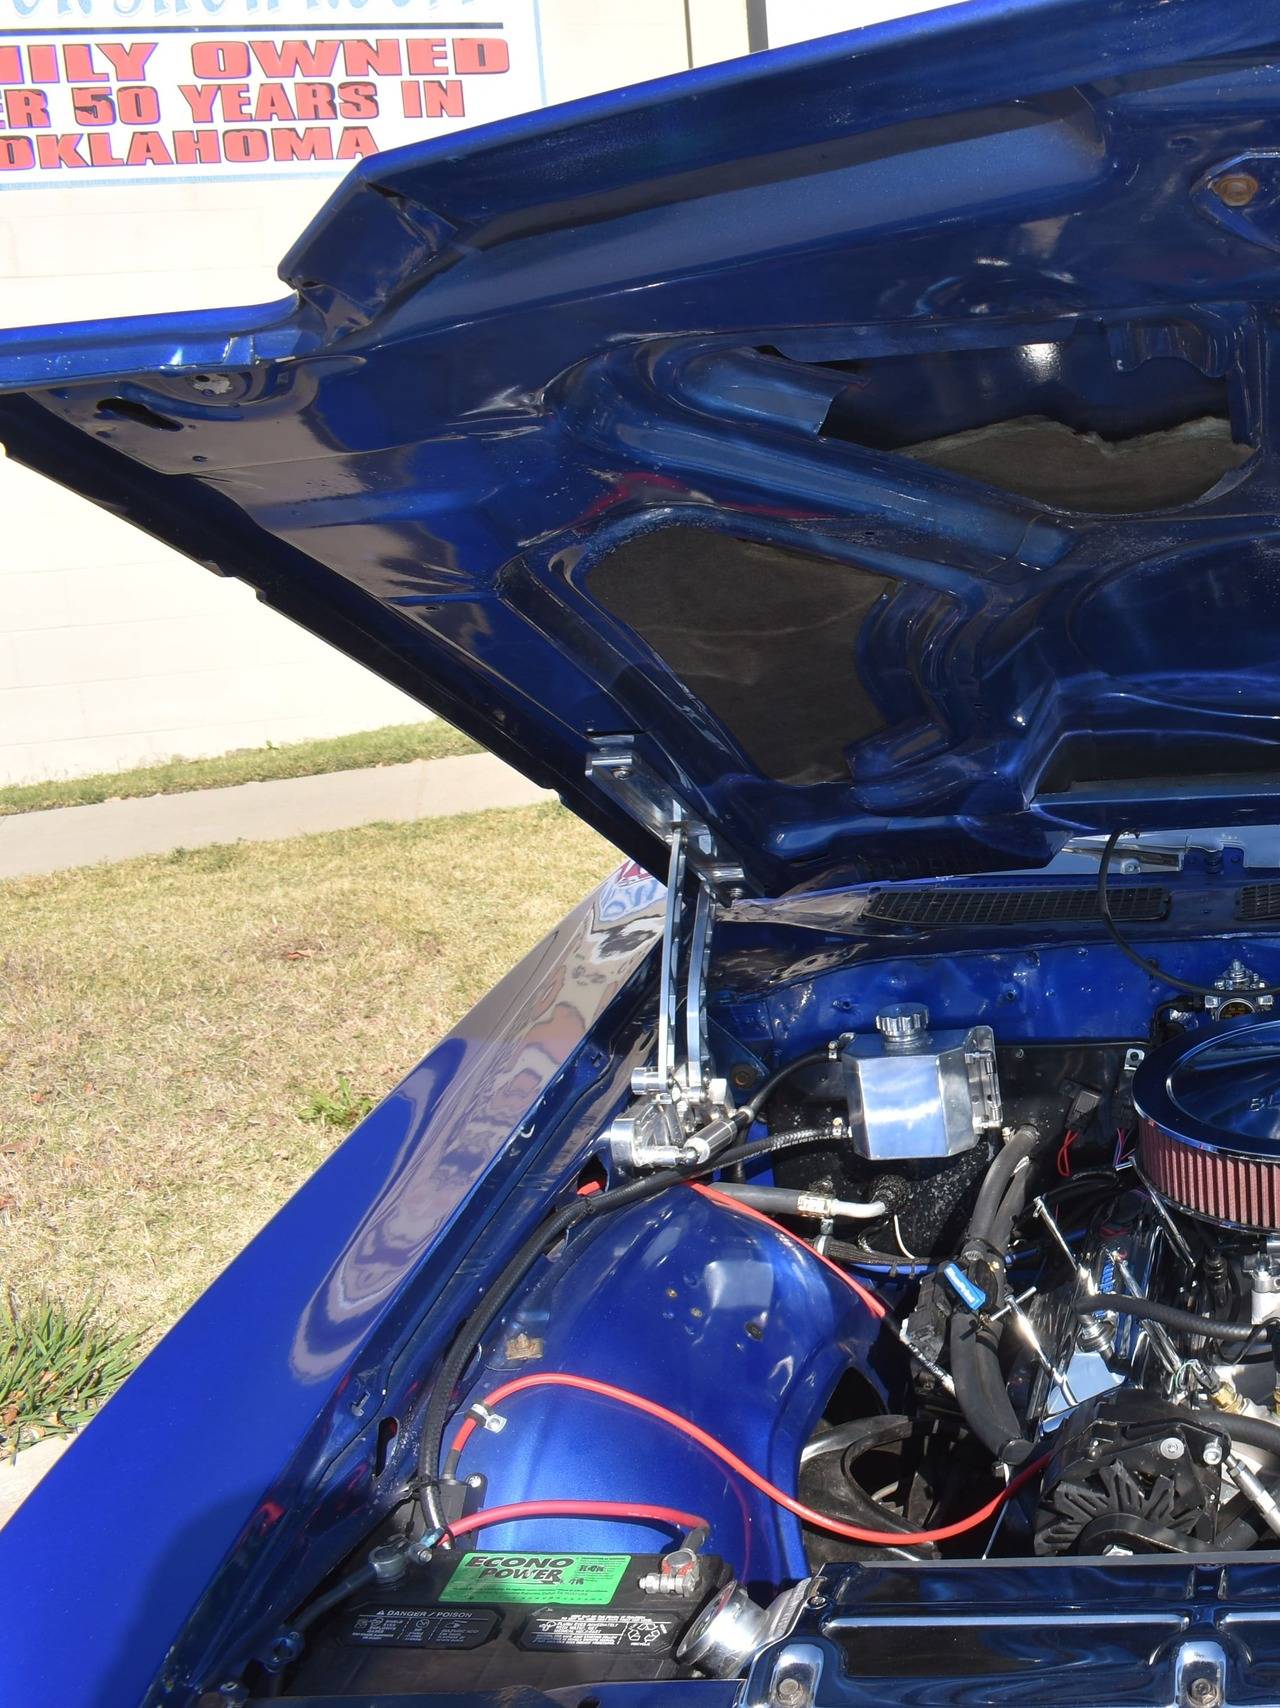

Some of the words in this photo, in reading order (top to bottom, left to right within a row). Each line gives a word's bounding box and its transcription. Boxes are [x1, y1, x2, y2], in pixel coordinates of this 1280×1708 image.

[190, 37, 511, 79] OWNED
[0, 87, 51, 130] R
[71, 85, 161, 127] 50
[177, 80, 380, 123] YEARS
[400, 79, 466, 119] IN
[0, 126, 380, 172] OKLAHOMA
[464, 1555, 575, 1569] ECONO
[479, 1567, 563, 1582] POWER
